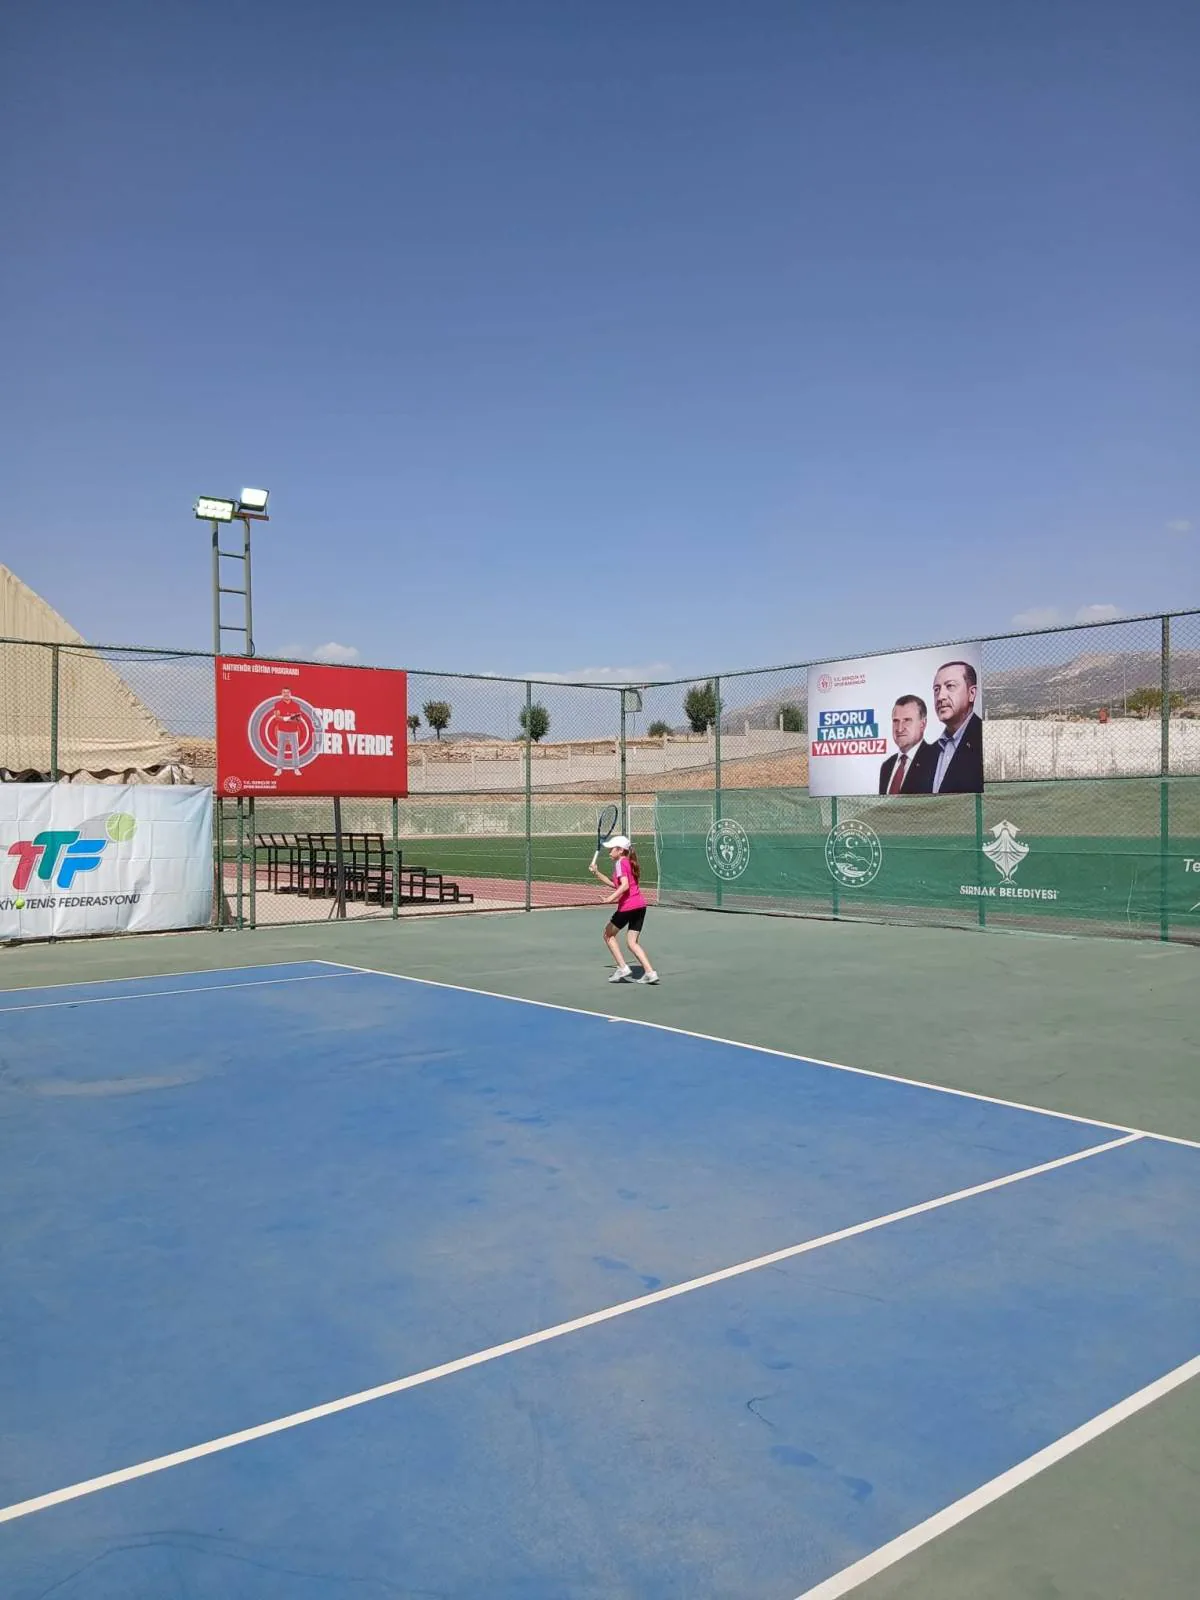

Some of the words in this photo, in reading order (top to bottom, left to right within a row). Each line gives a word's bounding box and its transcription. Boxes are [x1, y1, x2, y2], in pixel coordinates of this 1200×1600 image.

[311, 707, 356, 731] SPOR
[824, 711, 867, 725] SPORU
[821, 726, 873, 741] TABANA
[346, 733, 394, 756] YERDE
[814, 741, 885, 755] YAYIYORUZ
[7, 830, 108, 891] TTF
[25, 895, 56, 910] TENİS
[58, 893, 141, 909] FEDERASYONU
[999, 887, 1057, 900] BELEDİYESİ
